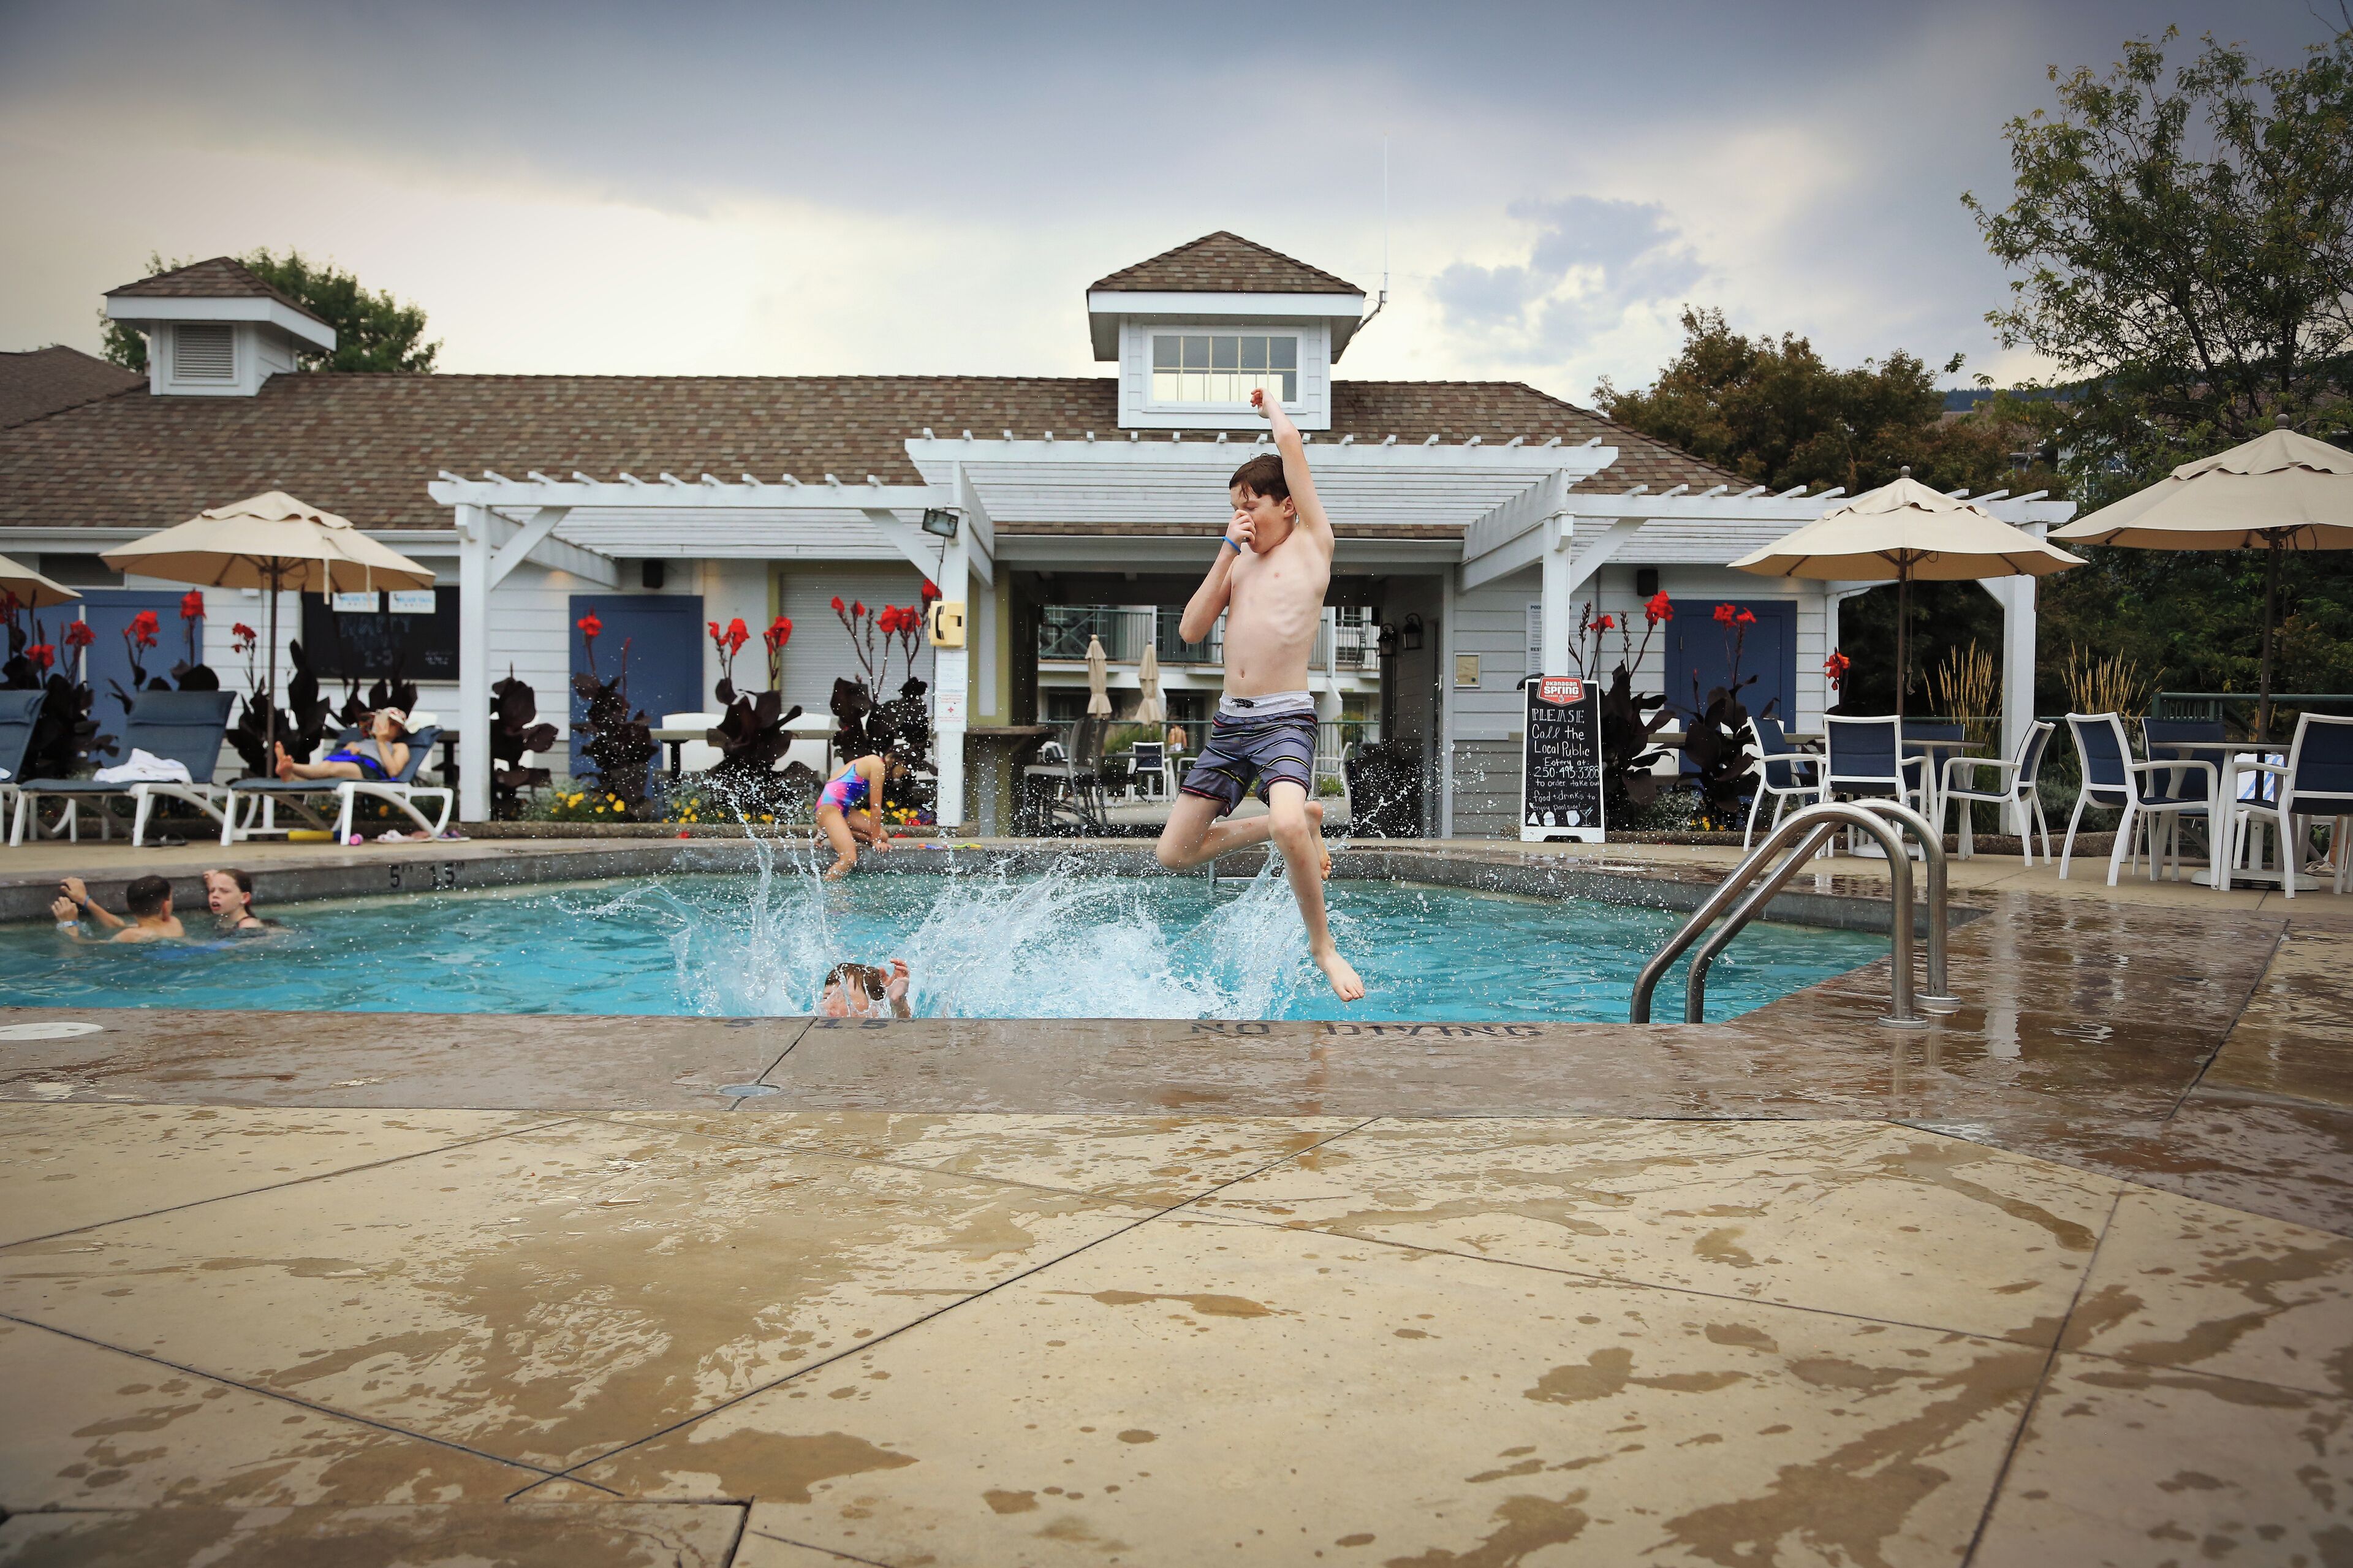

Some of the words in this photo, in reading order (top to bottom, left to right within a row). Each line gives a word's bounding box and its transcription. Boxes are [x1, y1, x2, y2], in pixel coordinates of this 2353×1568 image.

[1531, 708, 1585, 724] PLEASE
[1532, 724, 1560, 739] Call
[1564, 725, 1585, 741] the
[1534, 740, 1559, 754] Local
[1561, 741, 1590, 757] Public
[1544, 757, 1572, 768] Eatery
[1535, 778, 1545, 787] to
[1533, 790, 1550, 803] food
[1558, 790, 1585, 800] drinks
[1191, 1023, 1270, 1034] NO
[1325, 1024, 1544, 1036] DIVING
